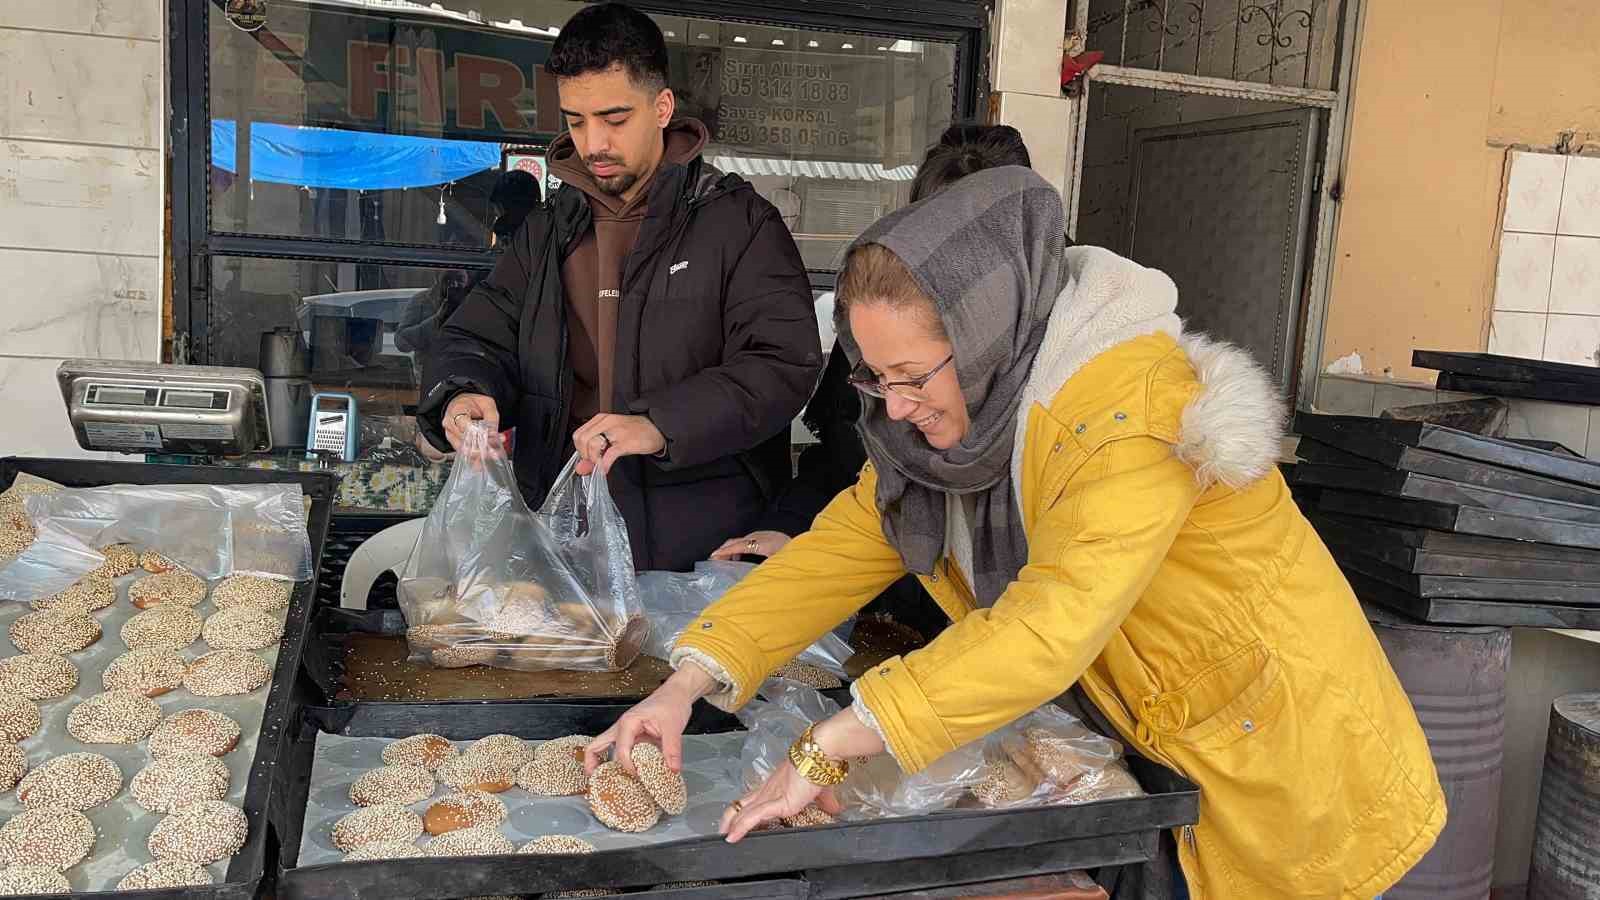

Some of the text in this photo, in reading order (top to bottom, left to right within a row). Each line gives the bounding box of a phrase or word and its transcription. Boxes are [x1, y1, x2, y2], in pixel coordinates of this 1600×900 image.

[770, 64, 832, 80] ALTUN
[759, 79, 793, 97] 314
[800, 81, 821, 101] 18
[827, 84, 849, 102] 83
[771, 107, 837, 124] KORSAL
[759, 126, 792, 145] 358
[799, 128, 821, 146] 05
[827, 130, 849, 147] 06
